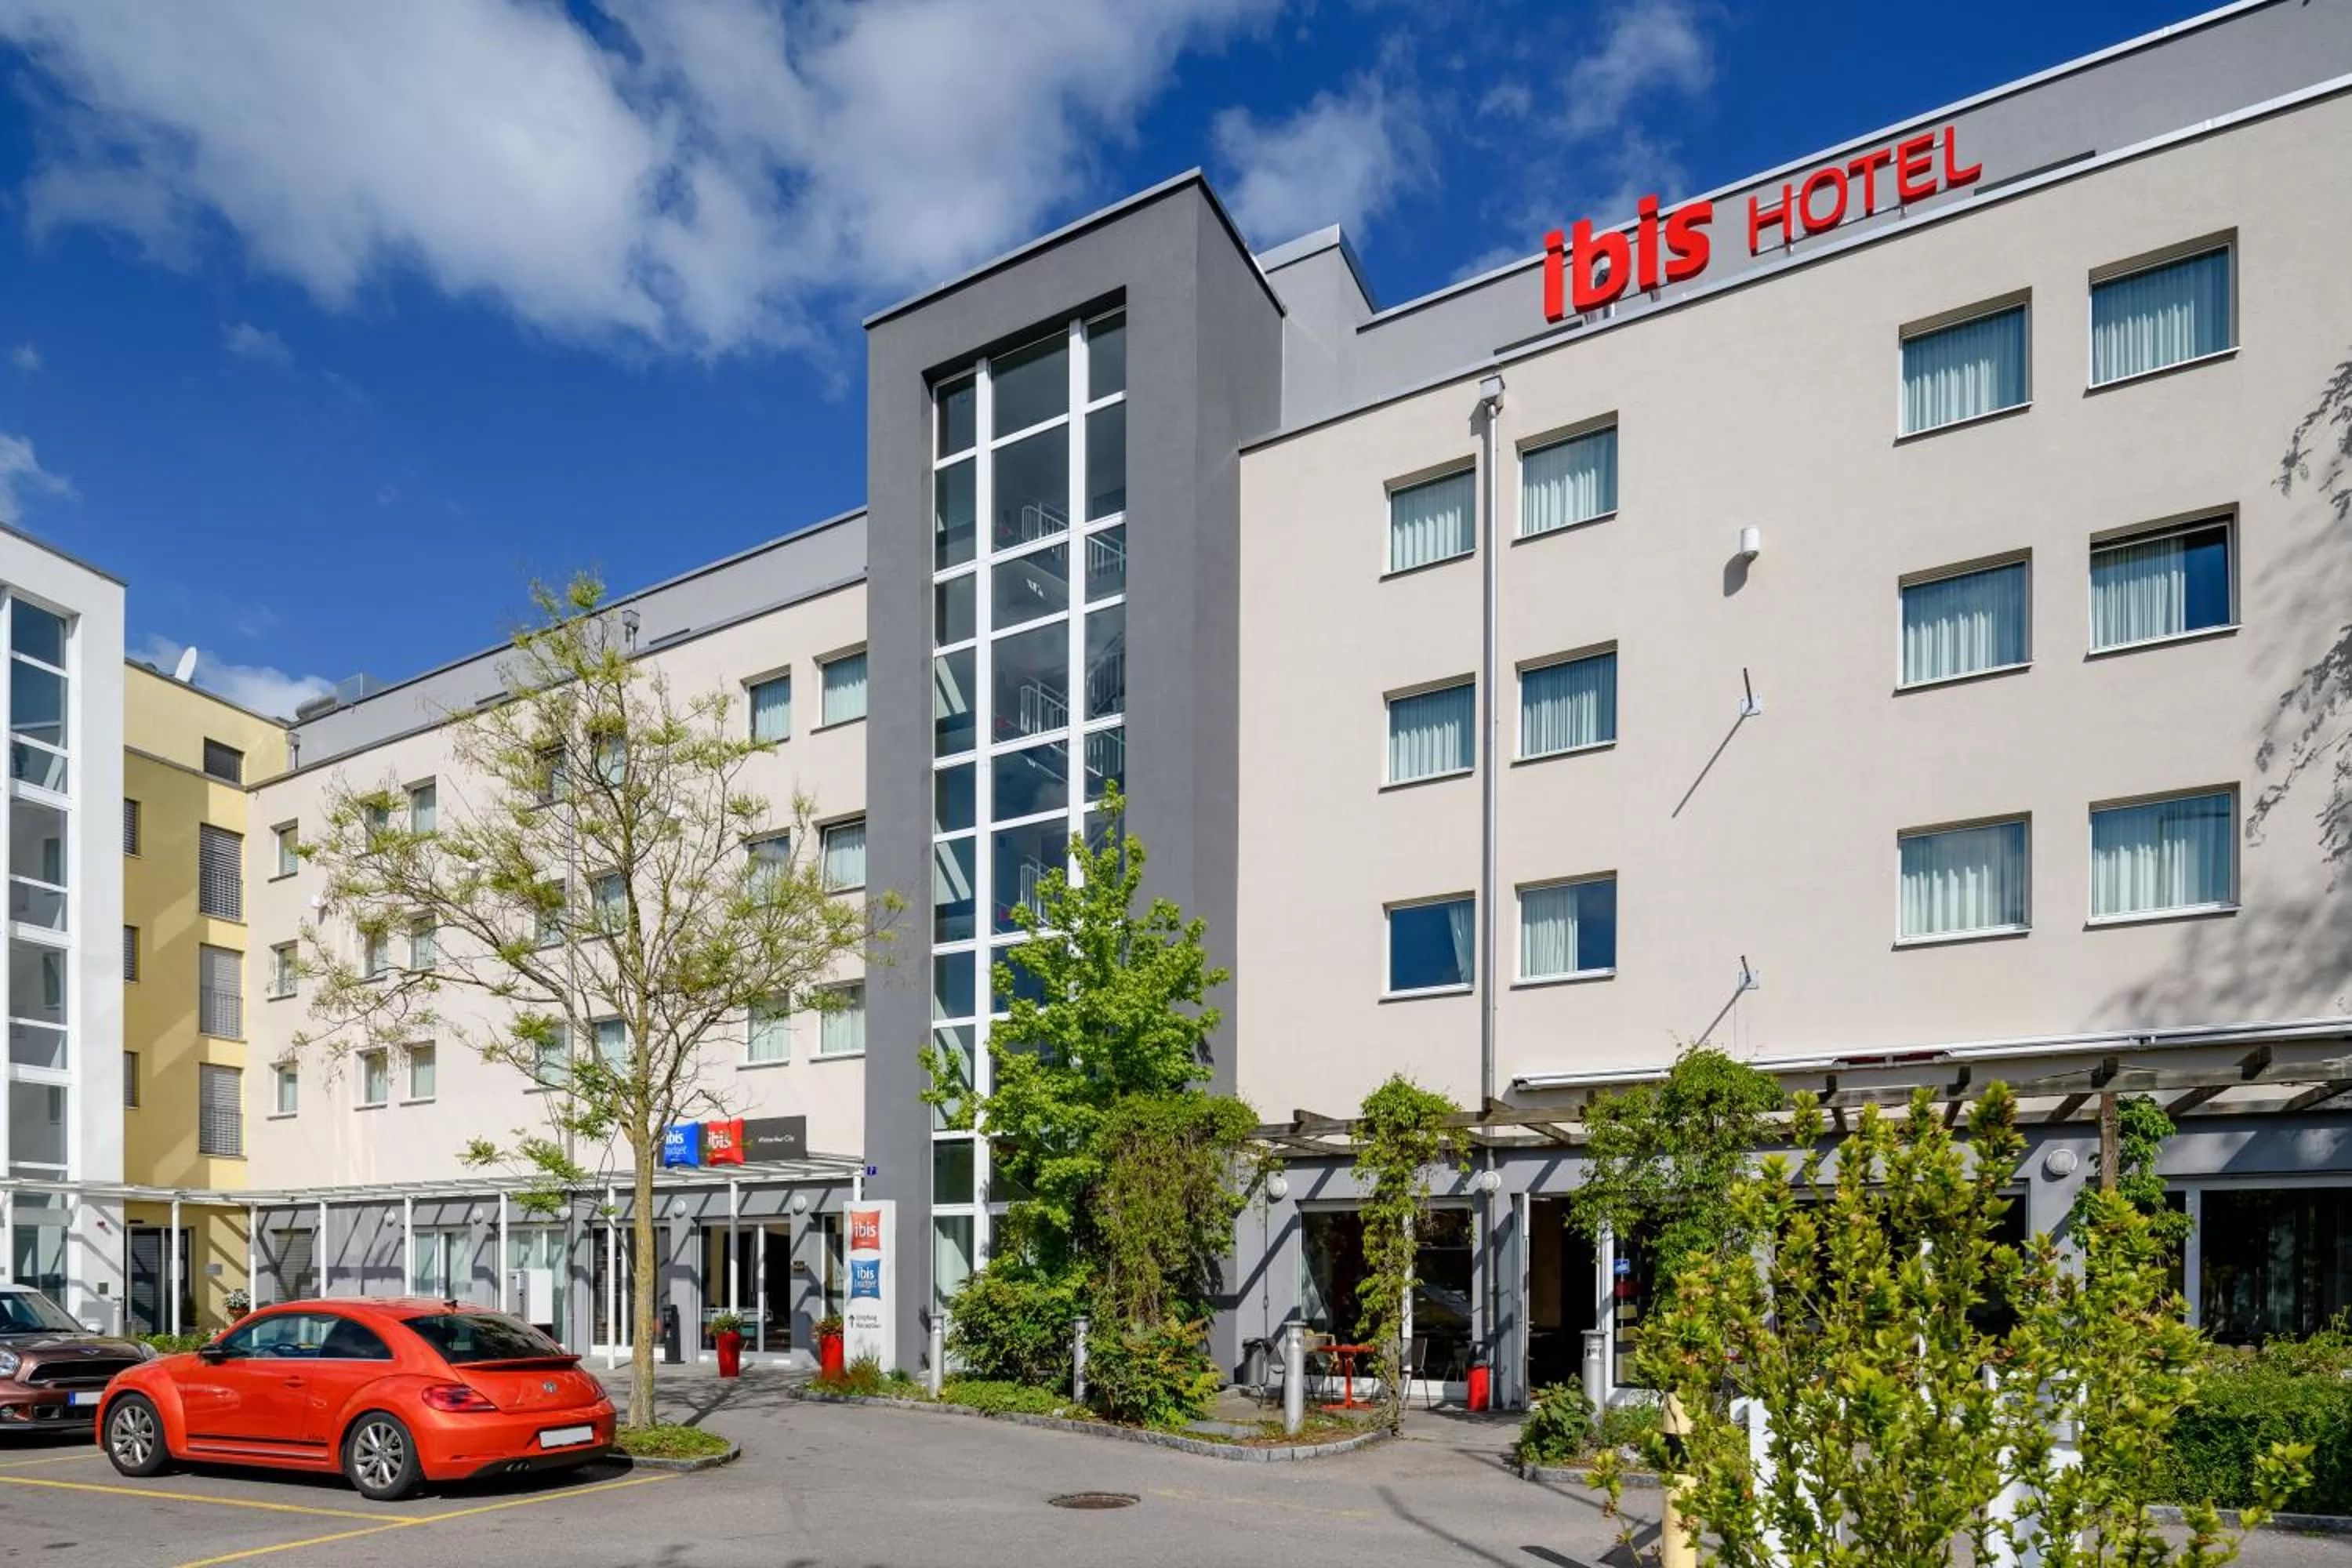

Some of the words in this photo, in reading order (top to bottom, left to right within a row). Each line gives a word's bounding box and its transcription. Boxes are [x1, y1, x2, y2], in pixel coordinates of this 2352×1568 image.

[1544, 194, 1713, 325] ibis
[1748, 125, 1983, 256] HOTEL
[707, 1130, 731, 1149] ibis
[855, 1220, 877, 1238] ibis
[857, 1266, 875, 1280] ibis
